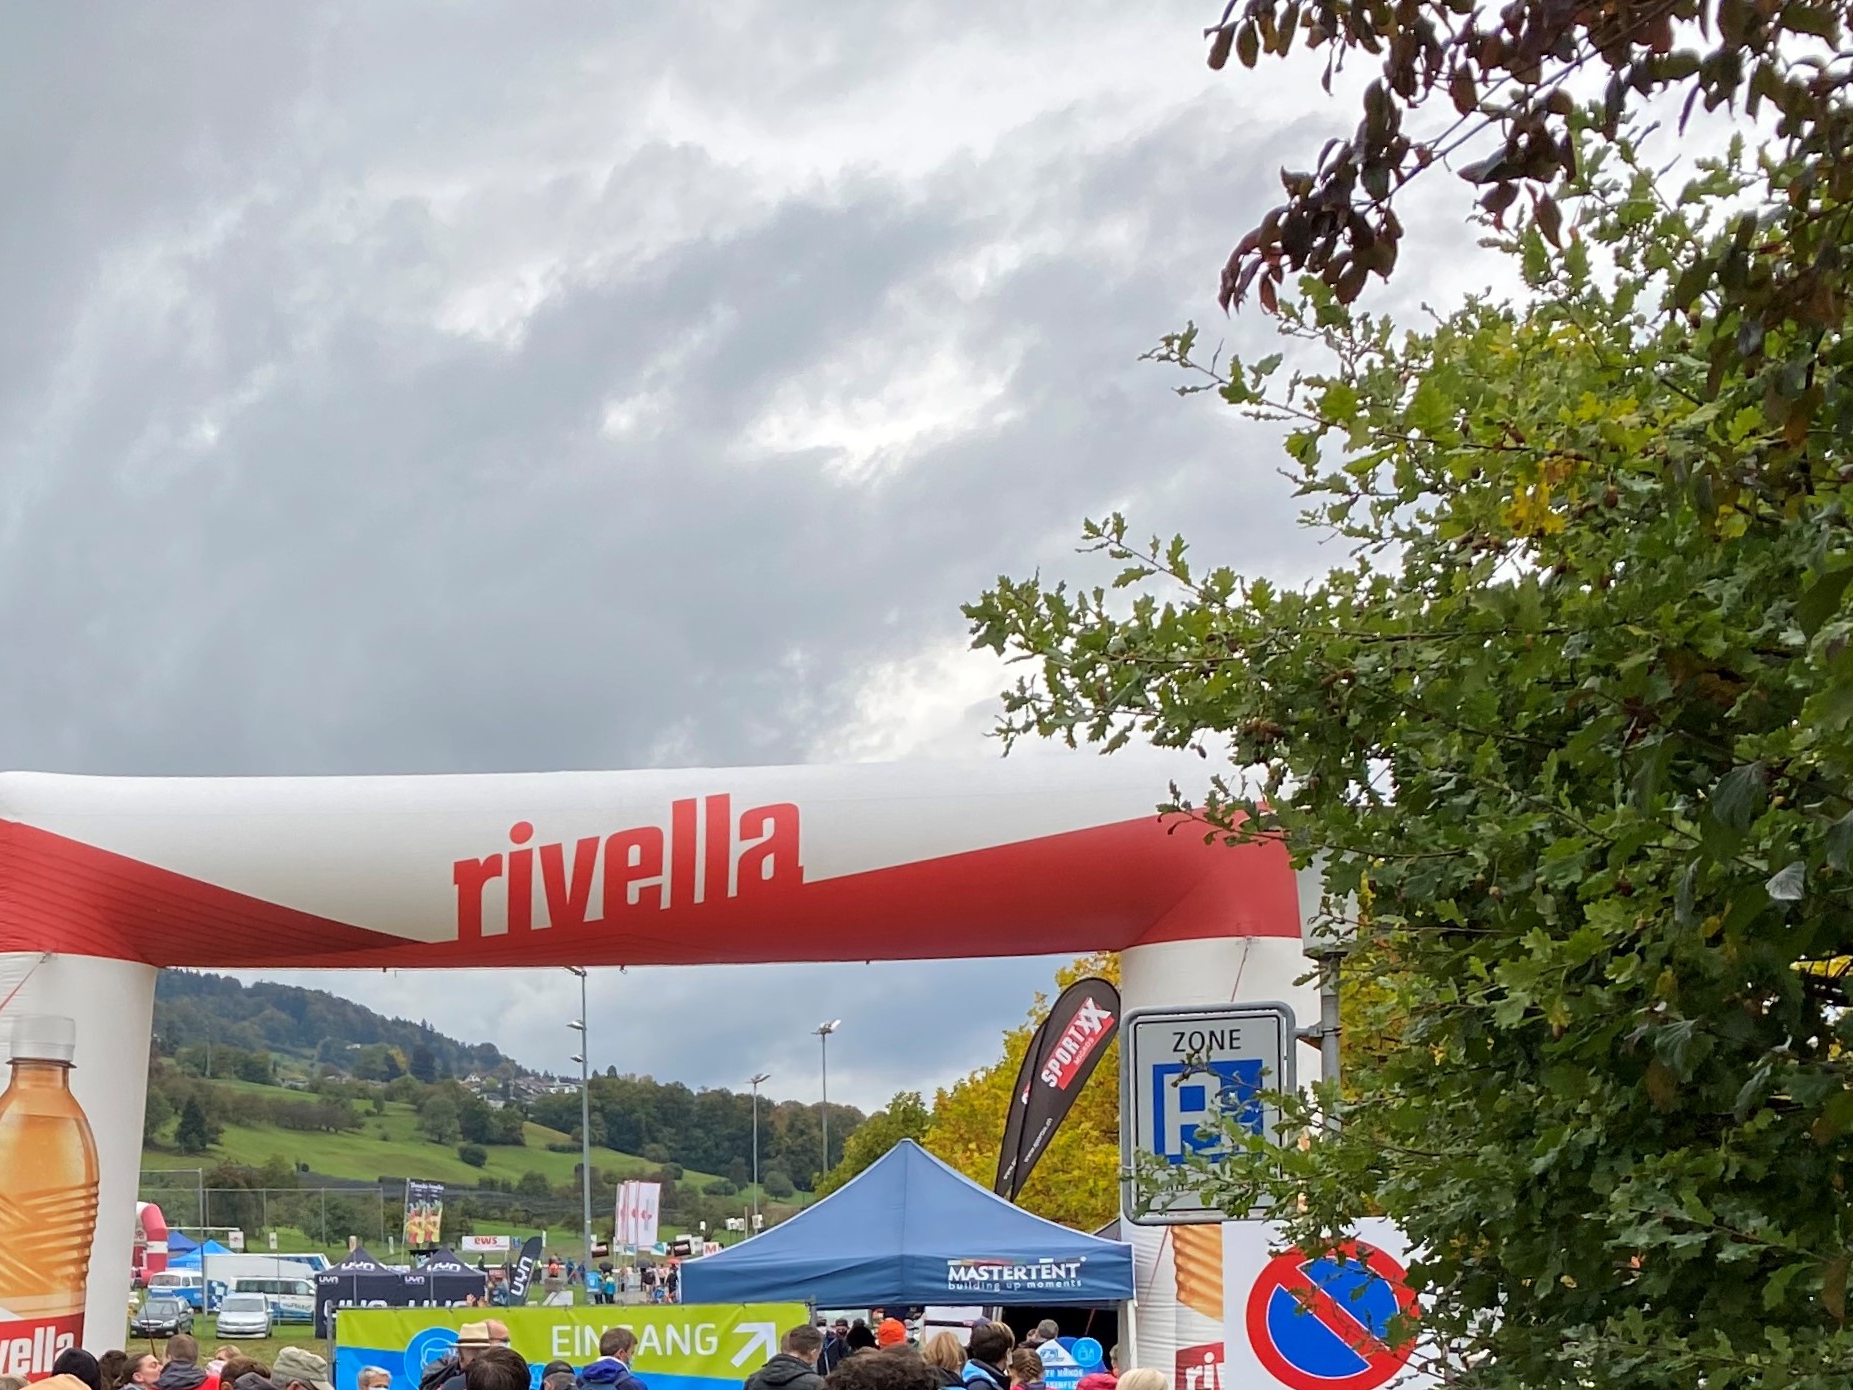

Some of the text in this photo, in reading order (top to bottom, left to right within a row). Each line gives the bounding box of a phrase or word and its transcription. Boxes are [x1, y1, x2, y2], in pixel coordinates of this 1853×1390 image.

[454, 793, 803, 940] rivella
[1041, 997, 1111, 1087] SPORTXX
[1172, 1029, 1241, 1052] ZONE
[948, 1262, 1081, 1281] MASTERTENT
[948, 1280, 1082, 1292] building up moments
[552, 1323, 718, 1357] EINANG
